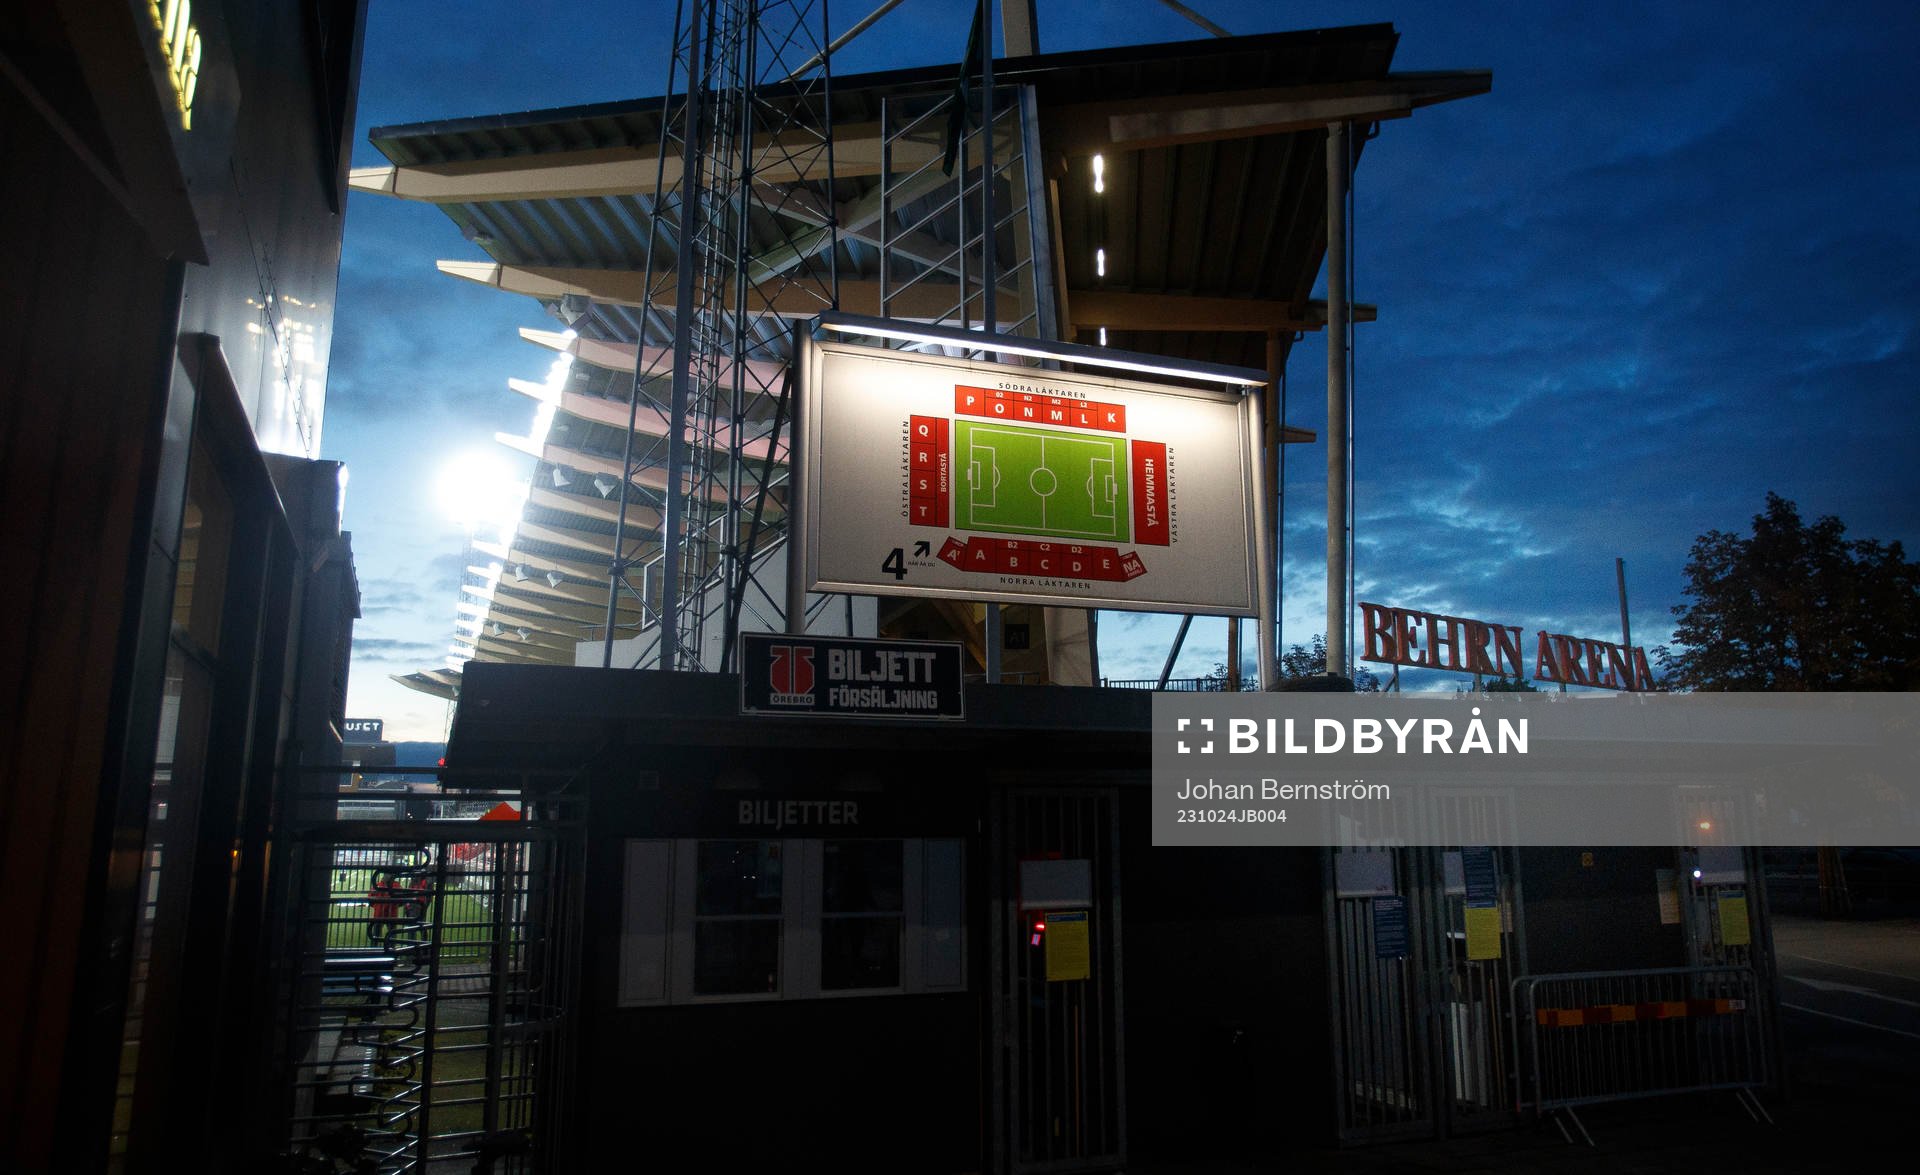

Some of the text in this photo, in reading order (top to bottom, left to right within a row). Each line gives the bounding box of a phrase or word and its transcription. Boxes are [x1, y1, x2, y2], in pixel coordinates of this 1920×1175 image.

[1035, 386, 1087, 399] LÄKTAREN
[966, 395, 975, 406] P
[994, 403, 1005, 414] O
[1023, 407, 1033, 418] N
[1051, 410, 1063, 421] M
[1081, 413, 1088, 424] L
[1107, 412, 1116, 423] K
[918, 425, 929, 437] Q
[919, 452, 928, 462] R
[901, 421, 910, 517] ÖSTRA LÄKTAREN
[1168, 447, 1176, 500] LÄKTAREN
[919, 479, 928, 490] S
[1145, 458, 1159, 527] HEMMASTÅ
[919, 506, 928, 517] T
[1007, 541, 1018, 549] B2
[1039, 543, 1050, 551] C2
[1071, 546, 1082, 554] D2
[975, 550, 985, 560] A
[881, 548, 908, 580] 4
[1010, 557, 1018, 567] B
[1041, 559, 1049, 570] C
[1073, 562, 1082, 572] D
[1103, 559, 1110, 569] E
[1000, 577, 1035, 586] NORRA
[1358, 602, 1656, 692] BEHRN ARENA
[828, 648, 936, 683] BILJETT
[773, 694, 813, 704] ÖREBRO
[829, 684, 938, 710] FÖRSÄLJNING
[738, 800, 860, 830] BILJETTER
